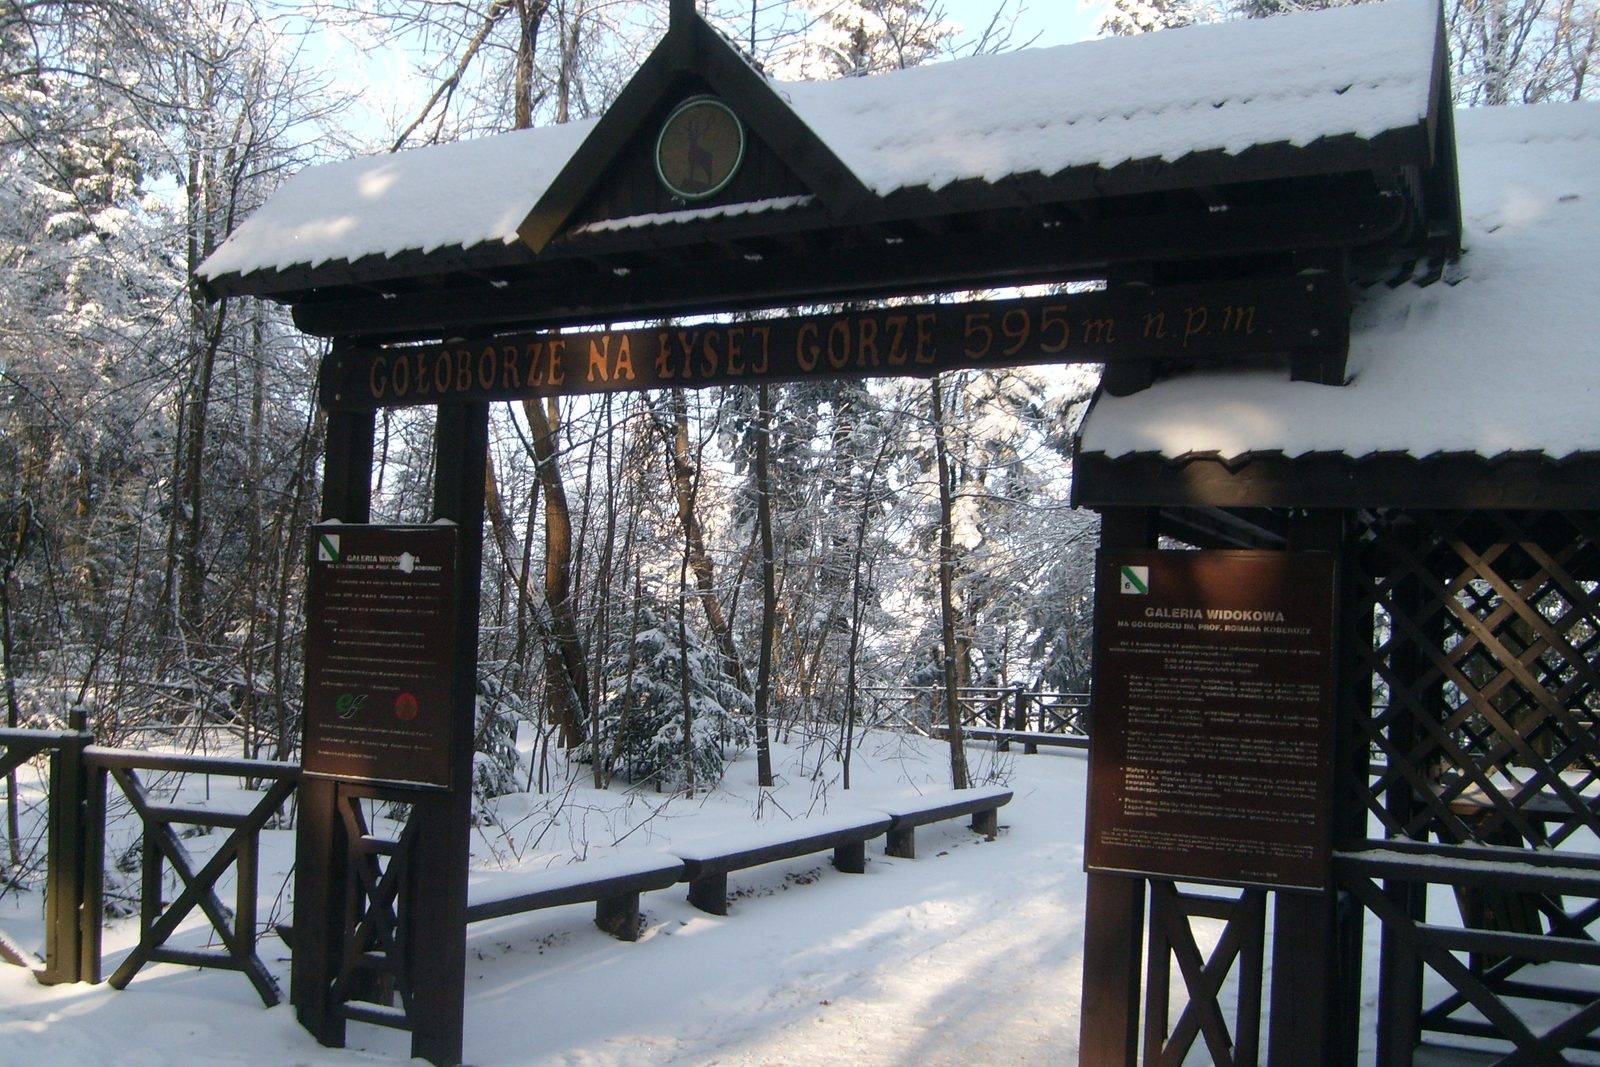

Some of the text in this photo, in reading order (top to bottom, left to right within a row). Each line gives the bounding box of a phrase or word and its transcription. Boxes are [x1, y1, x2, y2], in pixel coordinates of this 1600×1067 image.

[369, 337, 566, 399] GOŁOBORZE
[586, 334, 636, 382] NA
[656, 326, 771, 379] ŁYSEJ
[796, 312, 937, 373] GÓRZE
[1124, 582, 1131, 590] 6
[1145, 606, 1285, 623] GALERIA WIDOKOWA
[1198, 624, 1224, 632] PROF.
[1224, 624, 1262, 634] ROMANA
